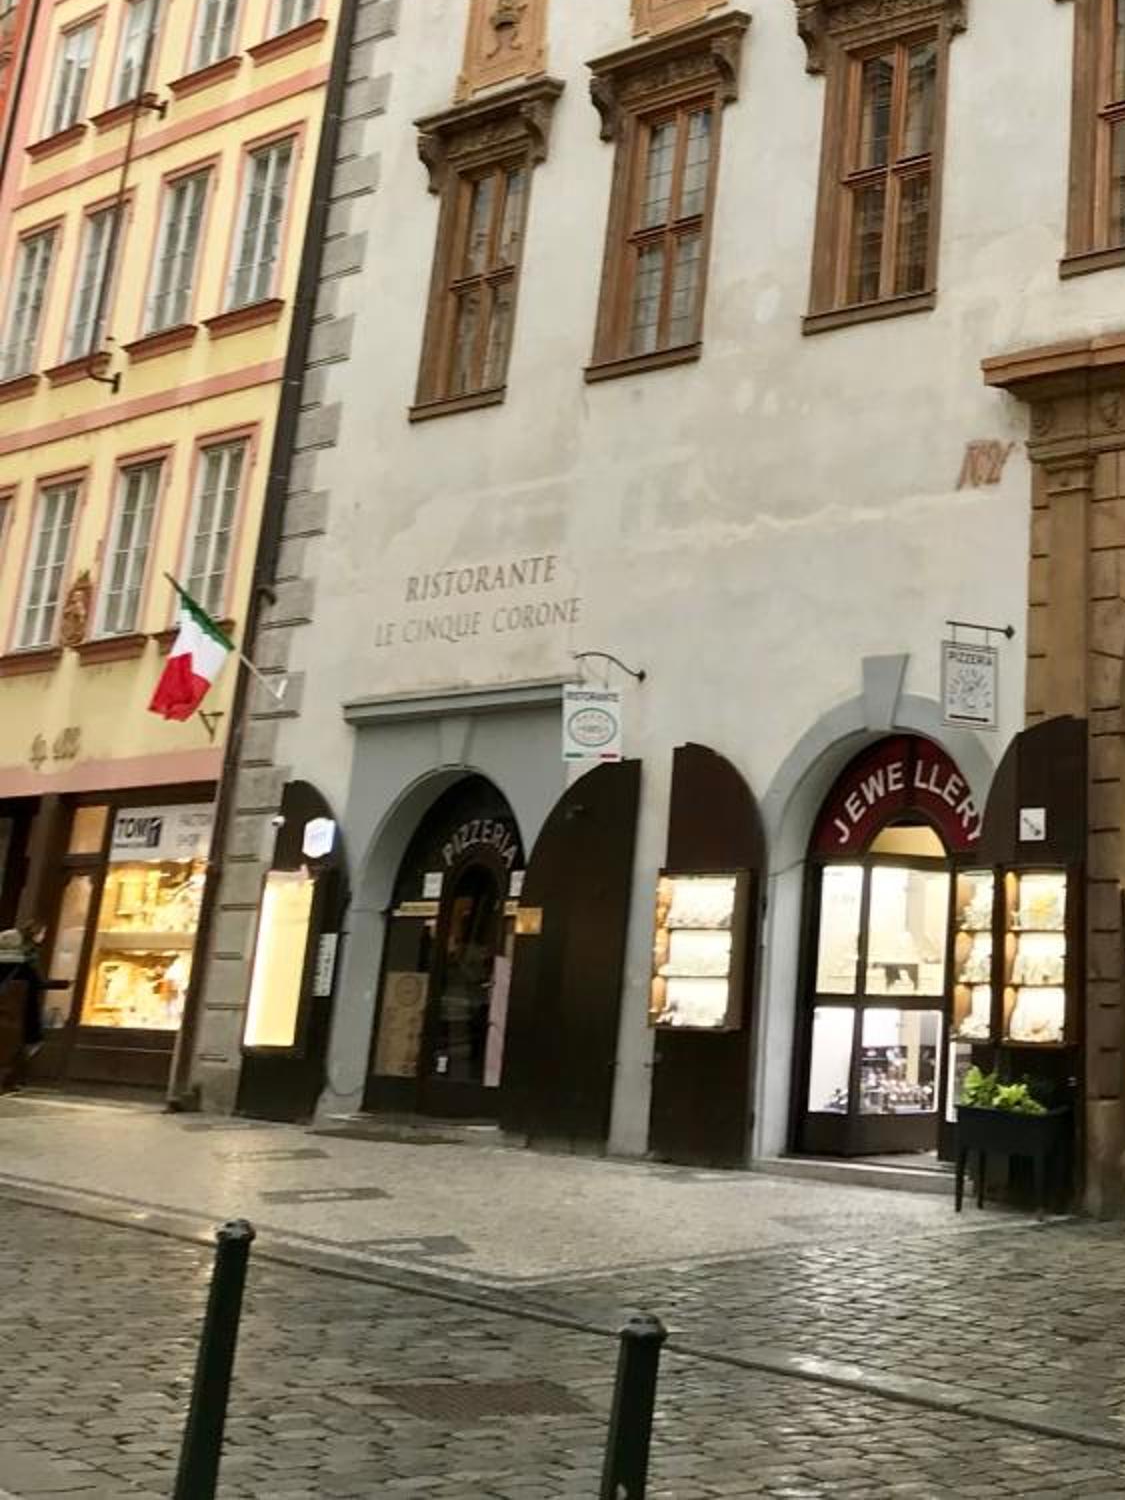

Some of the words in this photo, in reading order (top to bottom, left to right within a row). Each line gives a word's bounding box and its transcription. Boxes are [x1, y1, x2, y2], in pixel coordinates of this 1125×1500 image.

[405, 556, 558, 601] RISTORANTE
[374, 622, 397, 647] LE
[402, 611, 481, 643] CINQUE
[492, 598, 583, 633] CORONE
[442, 819, 518, 868] PIZZERIA
